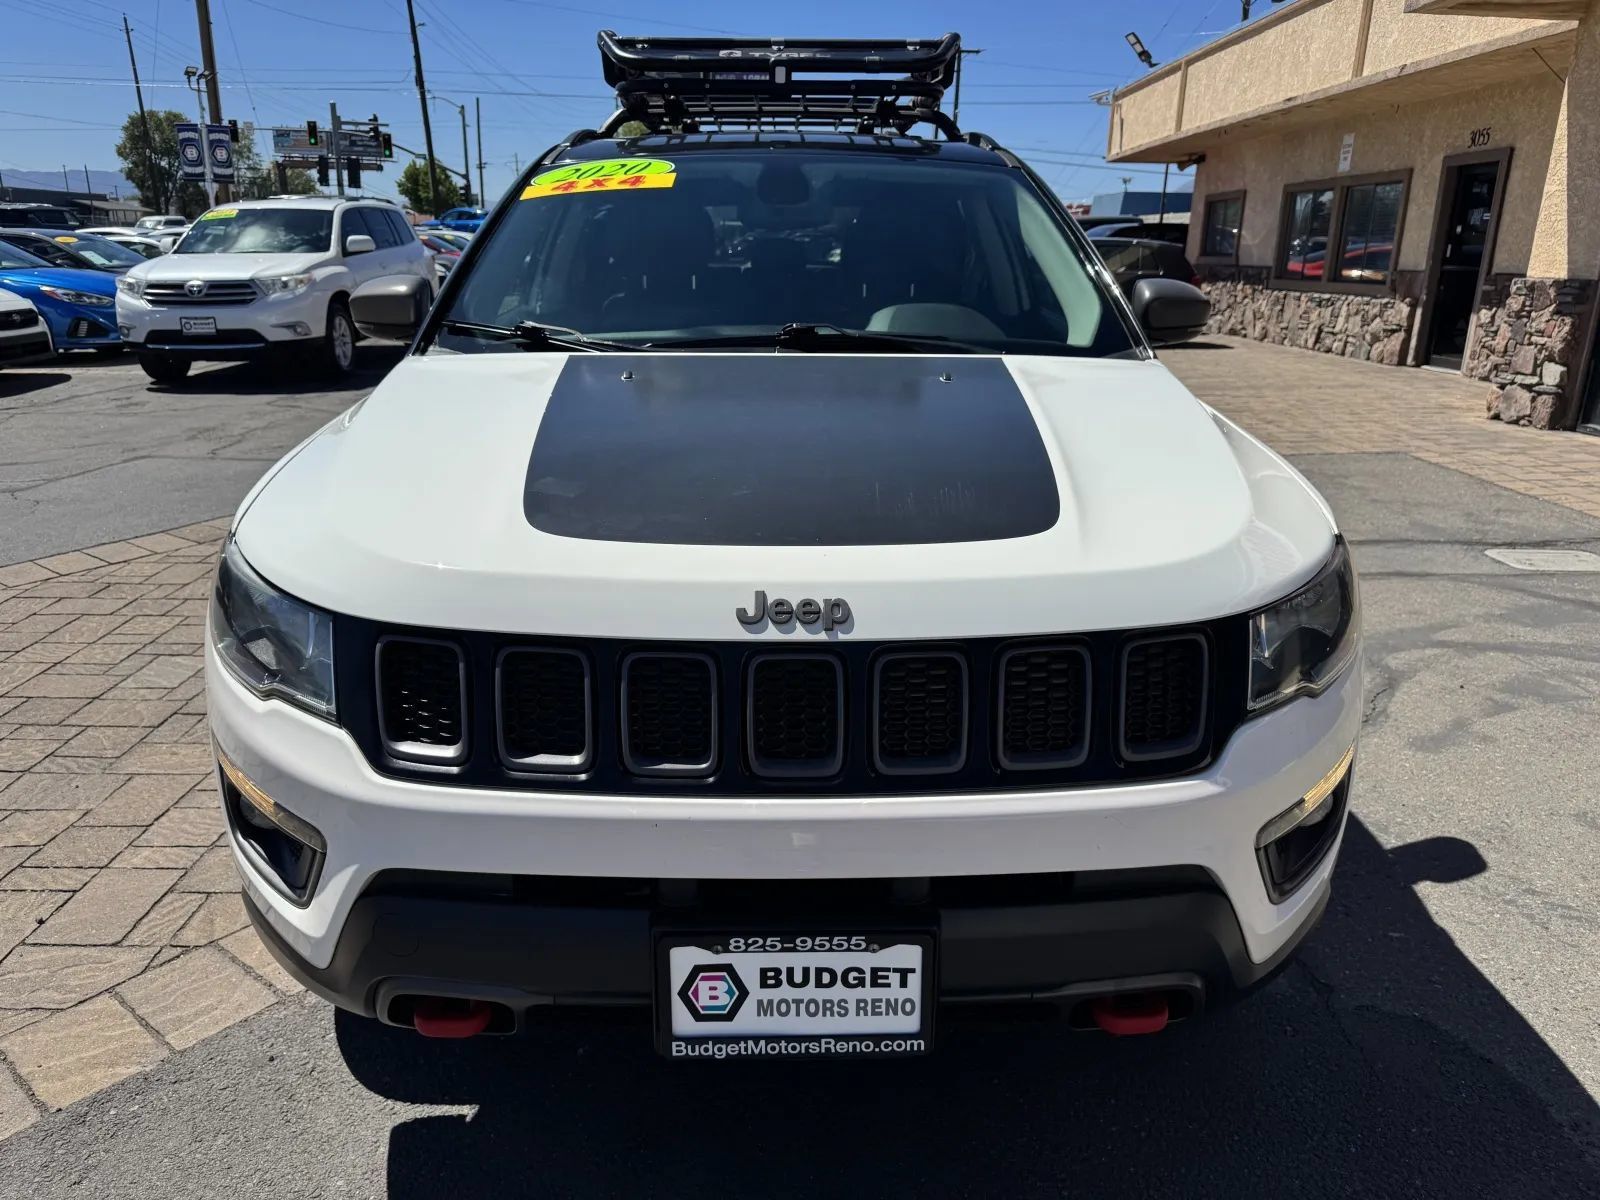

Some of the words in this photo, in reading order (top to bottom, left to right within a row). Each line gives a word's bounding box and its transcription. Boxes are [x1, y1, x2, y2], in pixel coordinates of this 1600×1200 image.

[1468, 127, 1492, 148] 3055
[552, 161, 652, 181] 2020
[735, 590, 852, 632] Jeep
[728, 936, 867, 952] 825-9555
[759, 966, 916, 989] BUDGET
[698, 980, 731, 1007] B
[756, 998, 849, 1018] MOTORS
[855, 997, 916, 1017] RENO
[671, 1038, 925, 1059] BudgetMotorsReno.com
